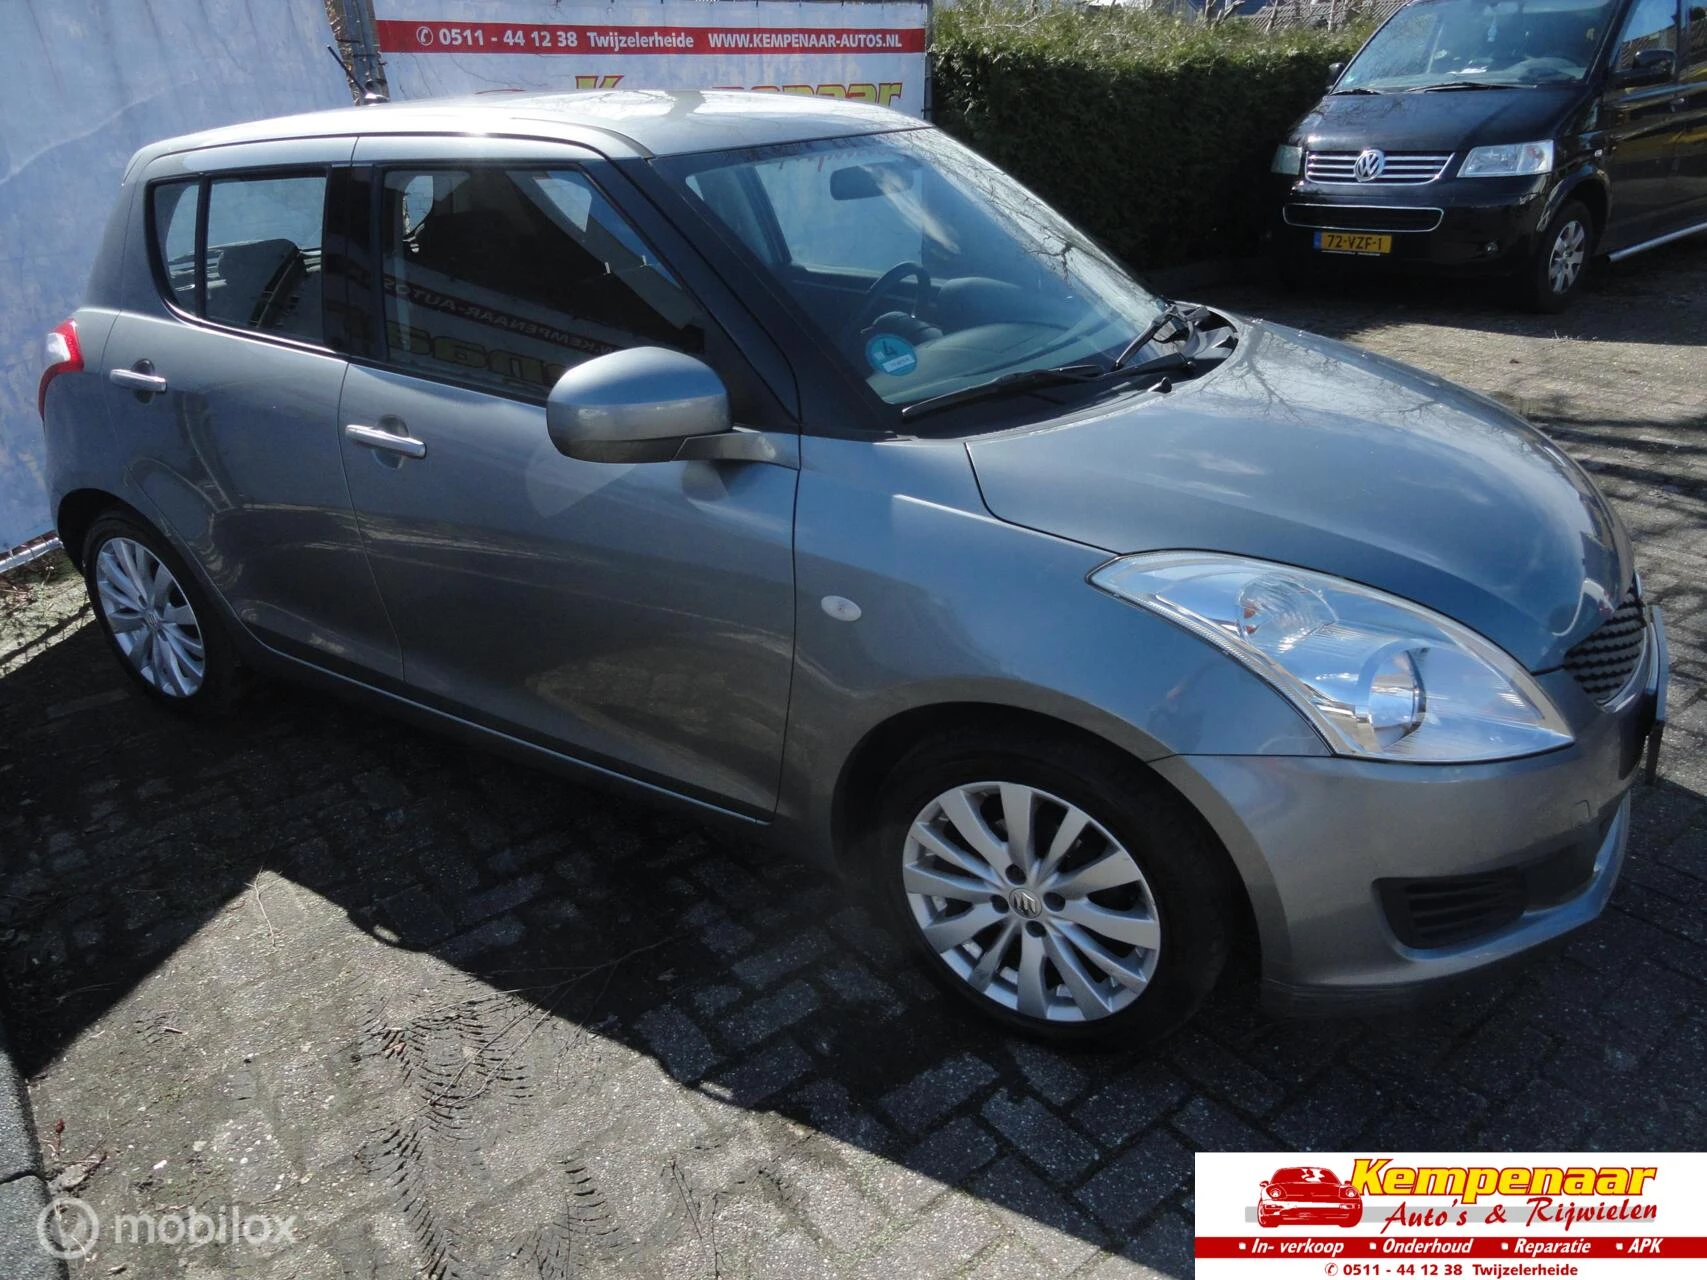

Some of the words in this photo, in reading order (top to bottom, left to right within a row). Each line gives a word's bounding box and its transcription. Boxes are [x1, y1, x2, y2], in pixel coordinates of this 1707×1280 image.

[439, 28, 484, 46] 0511
[503, 29, 526, 46] 44
[531, 30, 552, 47] 12
[557, 31, 578, 47] 38
[587, 31, 694, 52] Twijzelerheide
[708, 32, 902, 48] WWW.KEMPENAAR-AUTOS.NL
[1327, 234, 1382, 251] 72-VZF-1
